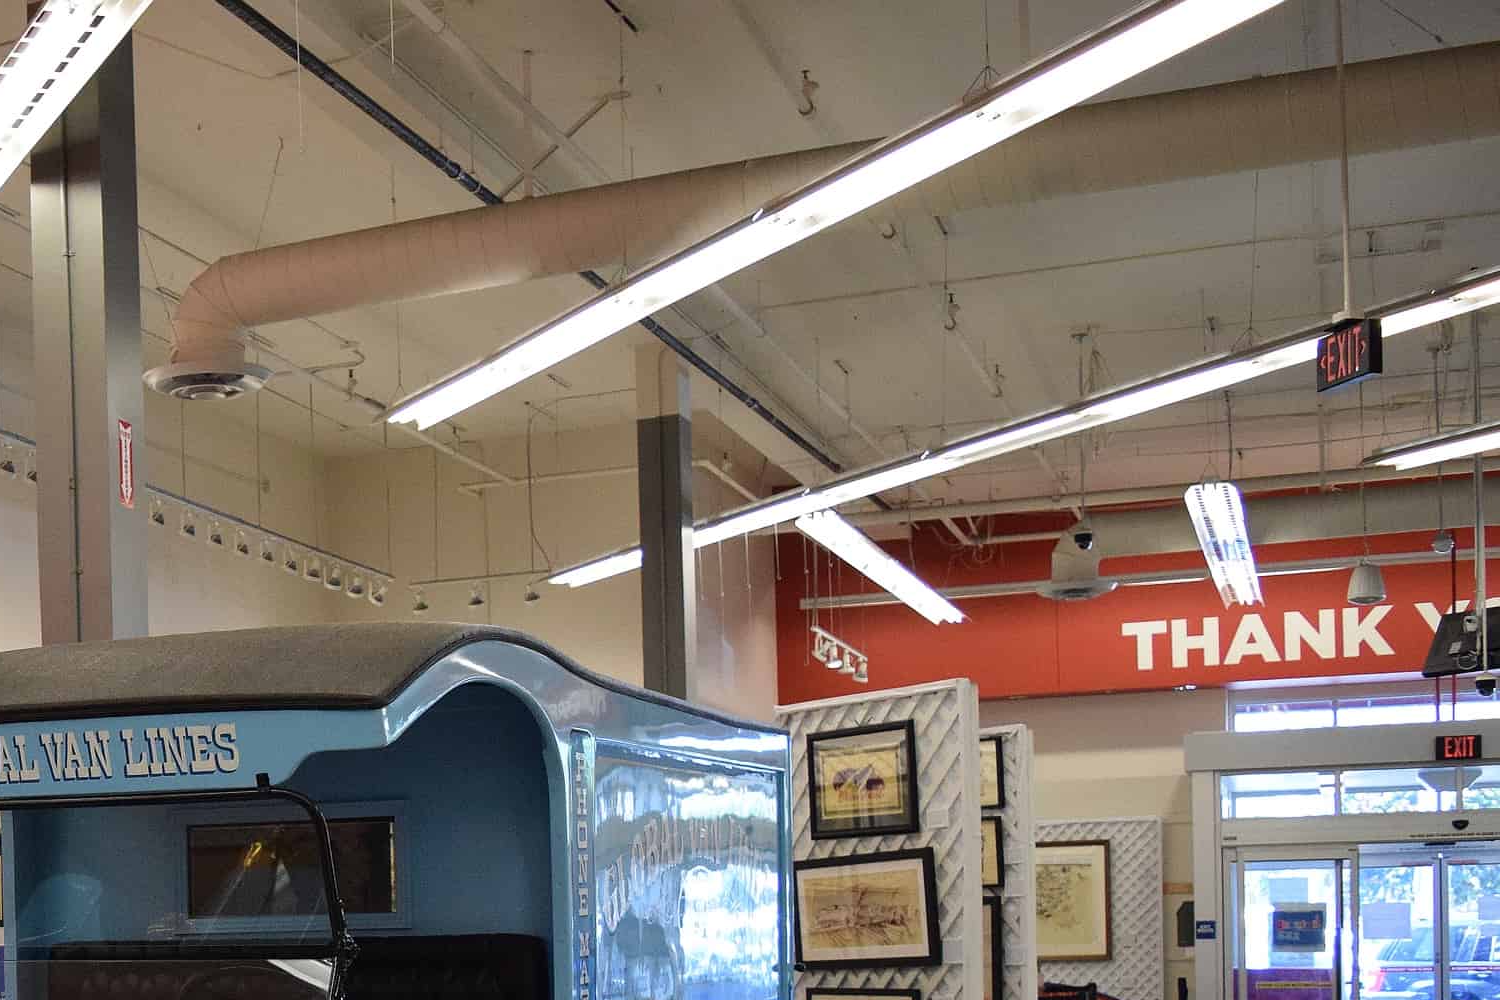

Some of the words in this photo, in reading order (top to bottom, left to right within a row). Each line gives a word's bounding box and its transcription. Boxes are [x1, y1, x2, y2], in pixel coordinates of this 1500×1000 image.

[1326, 324, 1363, 384] EXIT
[1121, 604, 1396, 672] THANK
[39, 729, 113, 782] VAN
[119, 721, 241, 778] LINES
[1443, 735, 1476, 759] EXIT
[575, 751, 590, 918] PHONE
